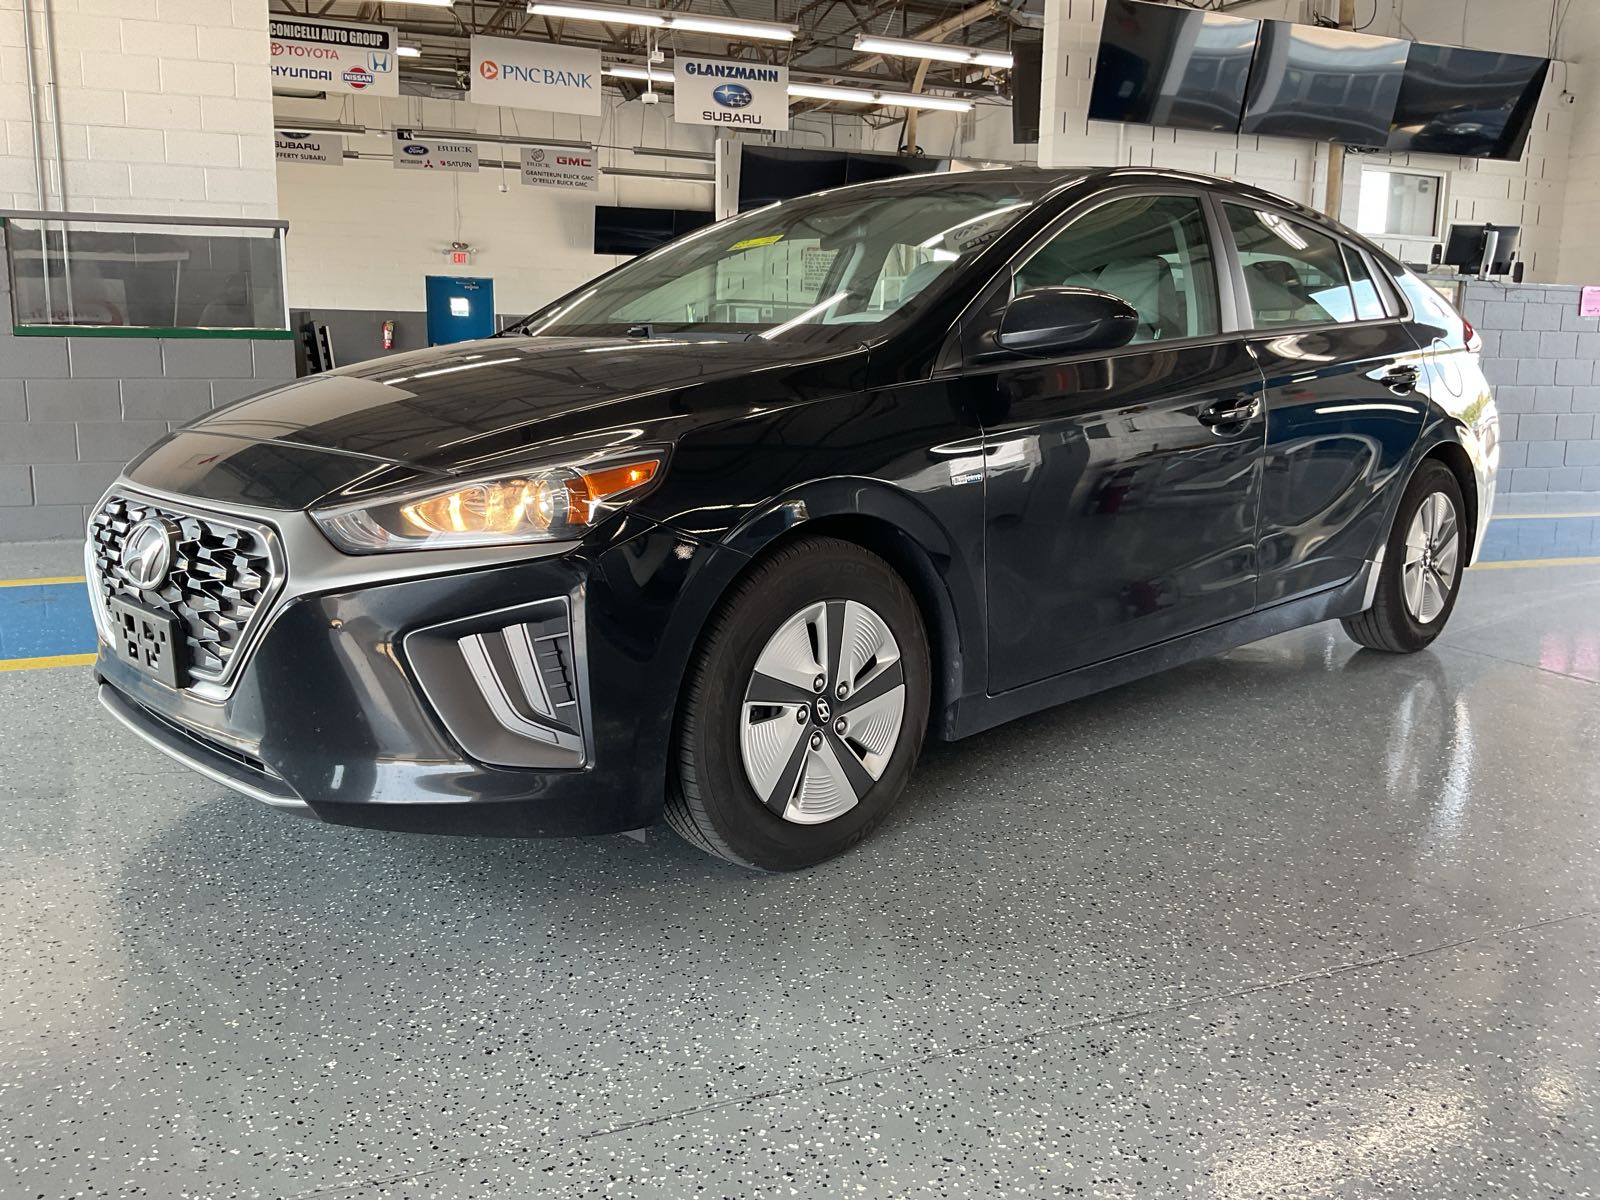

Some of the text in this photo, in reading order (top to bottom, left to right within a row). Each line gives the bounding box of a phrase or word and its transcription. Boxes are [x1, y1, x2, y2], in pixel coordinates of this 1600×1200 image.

[270, 22, 383, 47] CONICELLI AUTO GROUP
[286, 45, 339, 60] TOYOTA
[271, 66, 332, 81] HYUNDAI
[344, 73, 372, 83] NISSAN
[685, 62, 778, 82] GLANZMANN
[702, 111, 762, 125] SUBARU
[274, 140, 320, 151] SUBARU
[300, 153, 327, 162] SUBARU
[446, 160, 472, 168] SATURN
[556, 156, 592, 168] GMC
